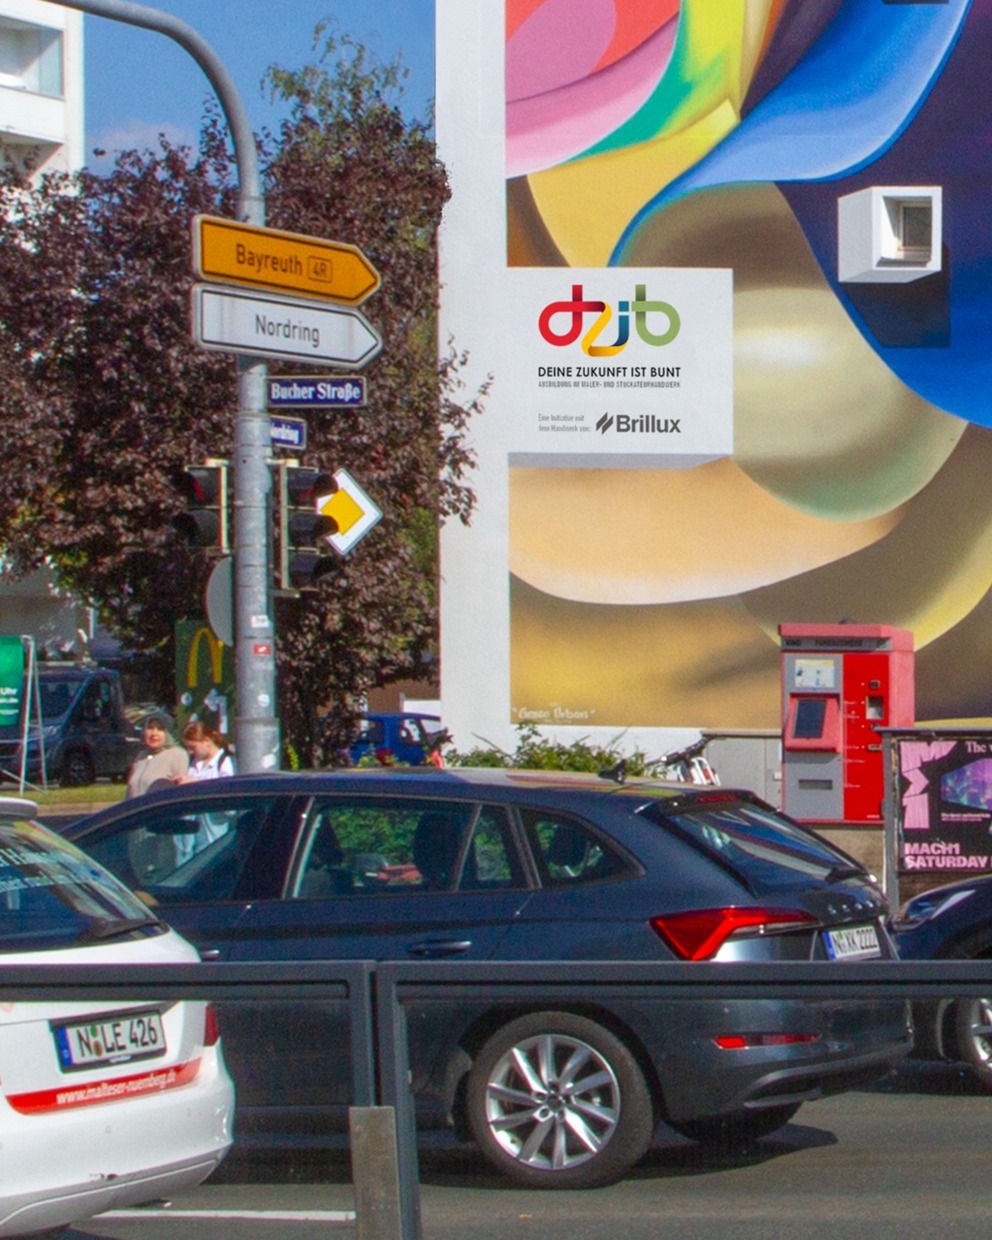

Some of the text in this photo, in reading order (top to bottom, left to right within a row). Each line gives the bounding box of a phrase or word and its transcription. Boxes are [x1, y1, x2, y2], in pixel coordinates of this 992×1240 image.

[235, 243, 328, 279] Bayreuth 4R
[255, 313, 320, 348] Nordring
[537, 366, 682, 378] DEINE ZUKUNFT IST BUNT
[271, 383, 361, 402] Bucher Straße
[616, 413, 682, 434] Brillux
[965, 741, 987, 754] The
[904, 842, 960, 855] MACH1
[904, 856, 989, 869] SATURDAY
[76, 1018, 158, 1057] N LE 426
[56, 1068, 177, 1105] www.malteser-nuernberg.de
